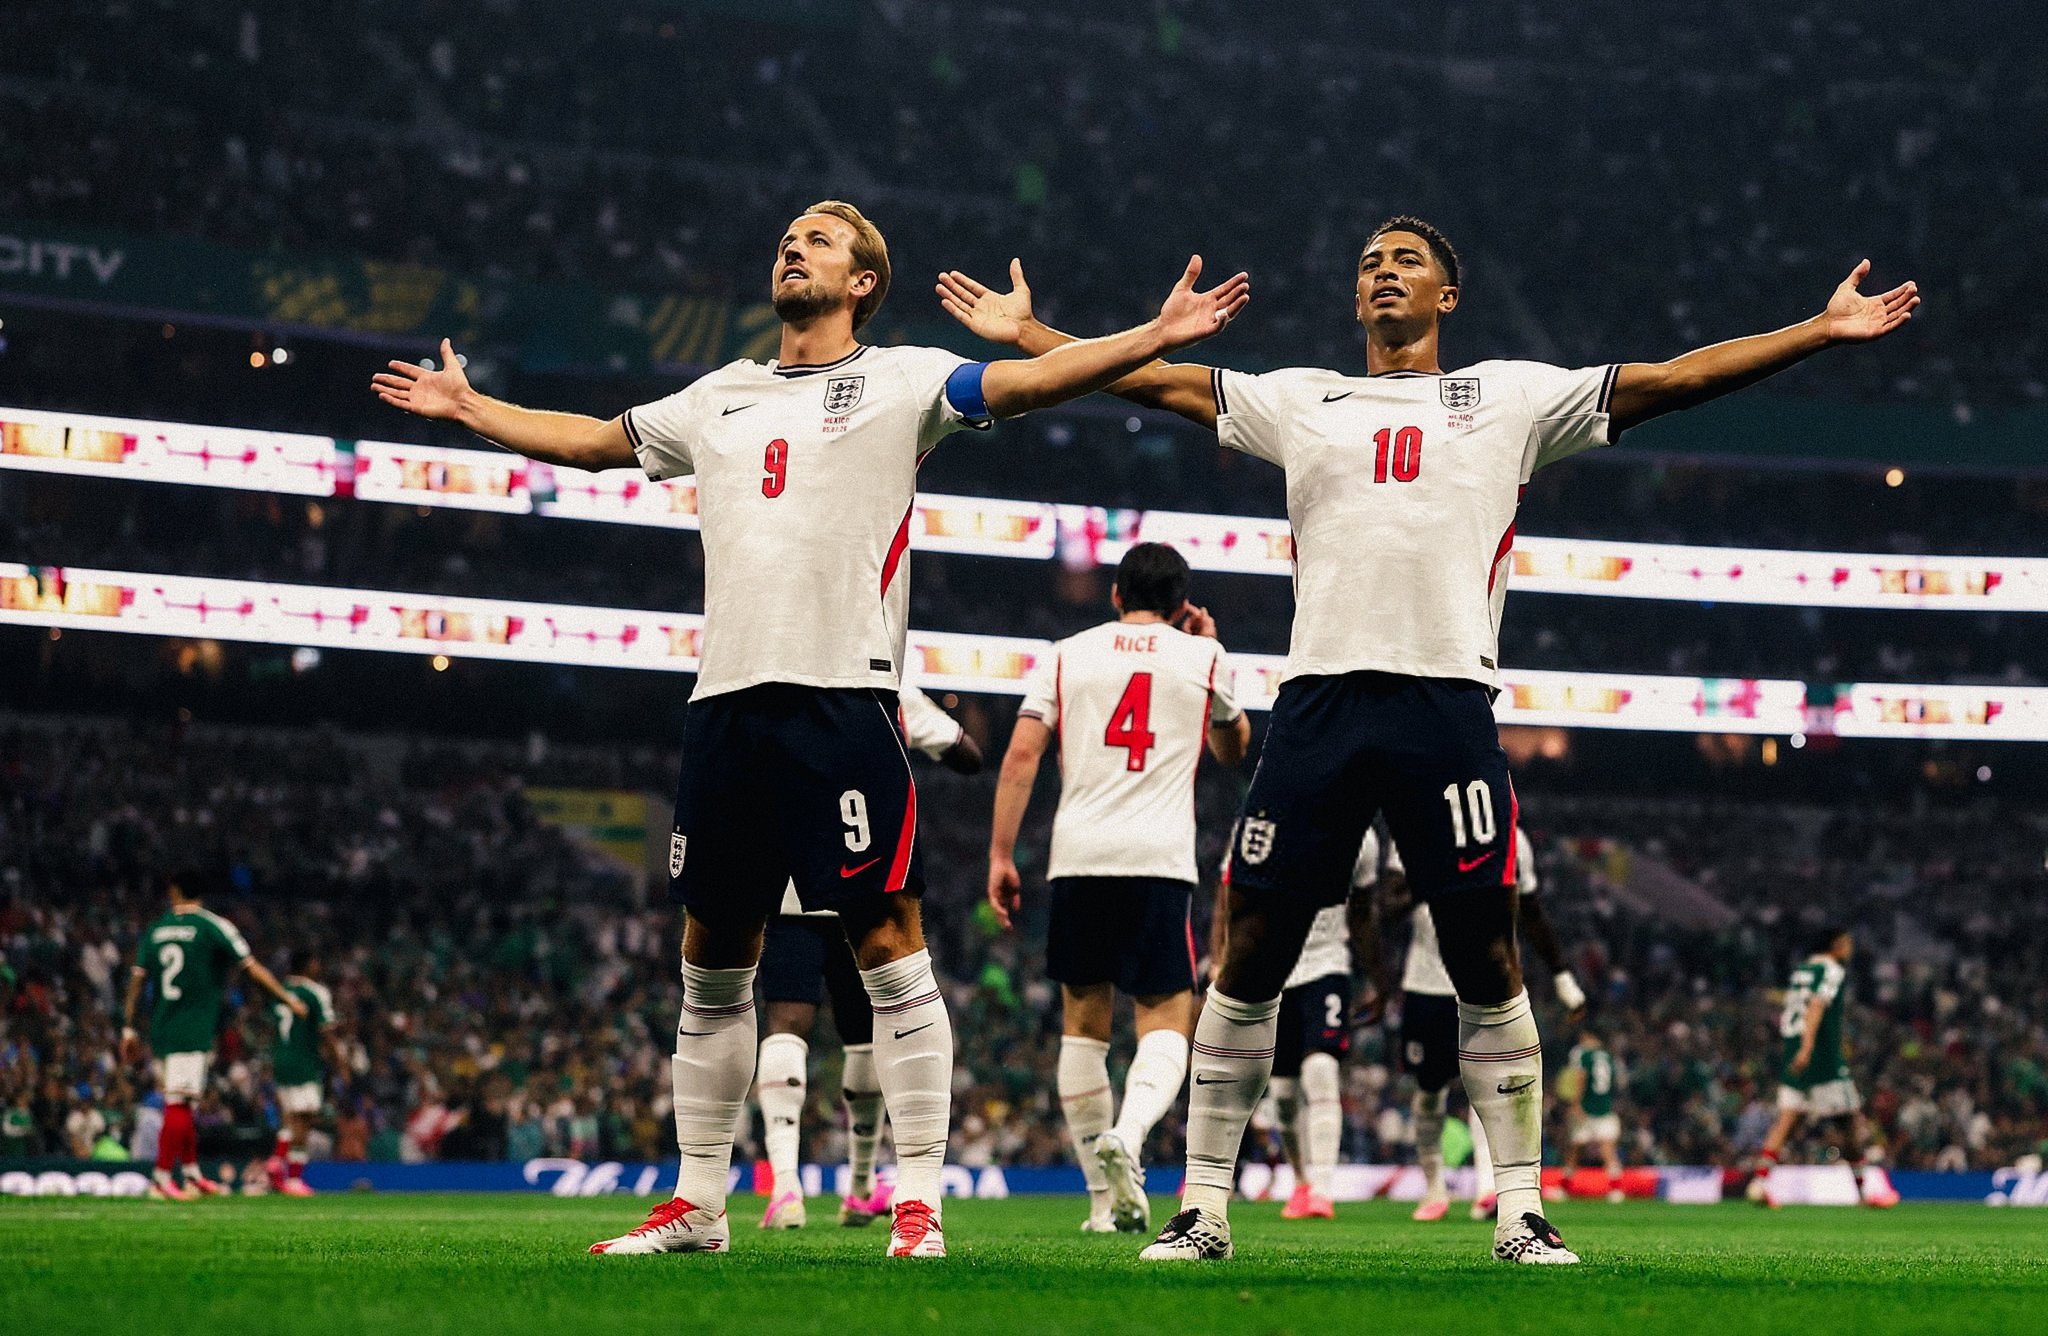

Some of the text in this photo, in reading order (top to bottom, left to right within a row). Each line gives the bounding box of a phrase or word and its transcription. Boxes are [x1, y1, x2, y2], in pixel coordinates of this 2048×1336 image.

[761, 438, 789, 499] 9
[1373, 425, 1423, 484] 10
[1113, 634, 1159, 653] RICE
[1104, 671, 1156, 772] 4
[839, 789, 872, 853] 9
[1443, 779, 1497, 848] 10
[158, 942, 185, 1001] 2
[1324, 993, 1343, 1028] 2
